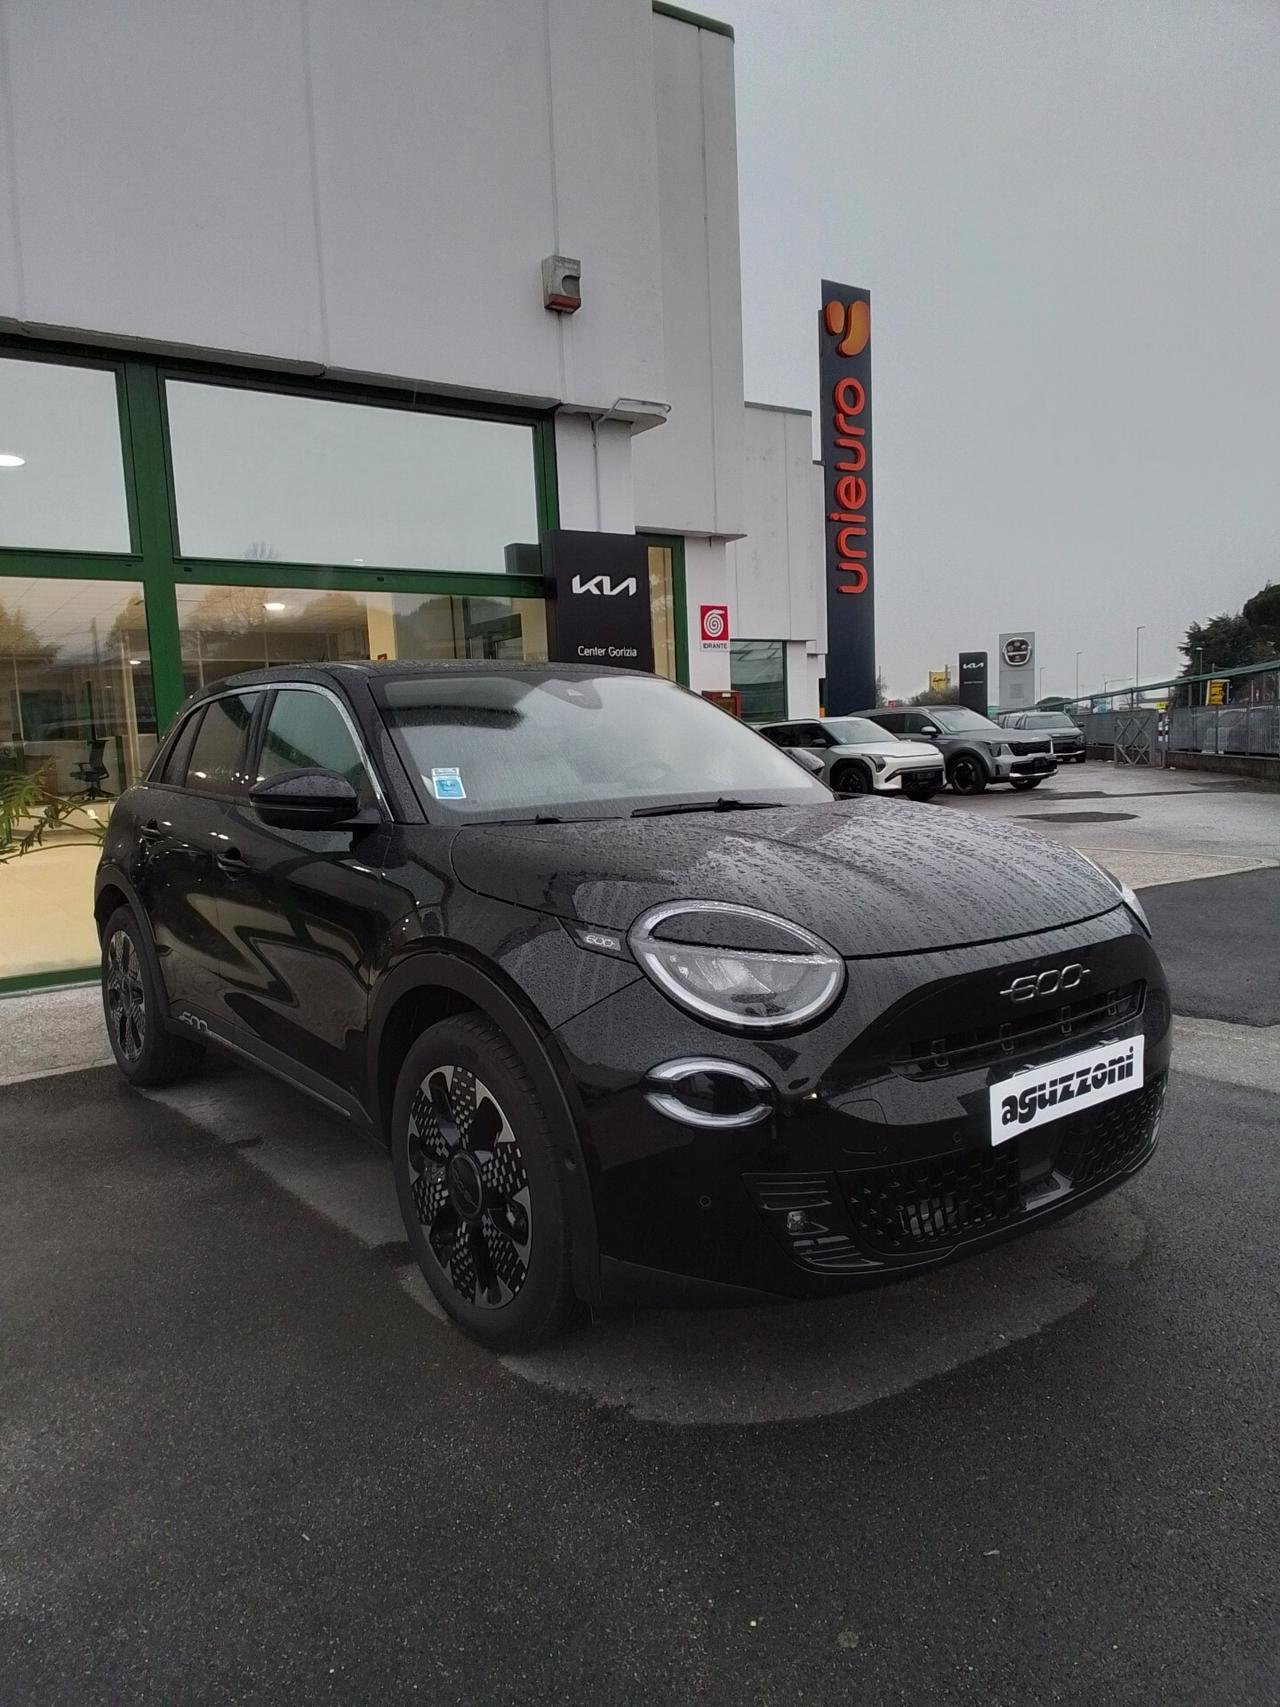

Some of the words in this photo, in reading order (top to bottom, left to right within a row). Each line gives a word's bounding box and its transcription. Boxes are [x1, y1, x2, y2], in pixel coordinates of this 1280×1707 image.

[829, 377, 868, 594] unieuro
[577, 646, 606, 657] Center
[608, 646, 638, 657] Gorizia
[585, 934, 615, 947] 600
[1000, 963, 1091, 1001] 600
[1002, 1046, 1134, 1125] aguzzoni
